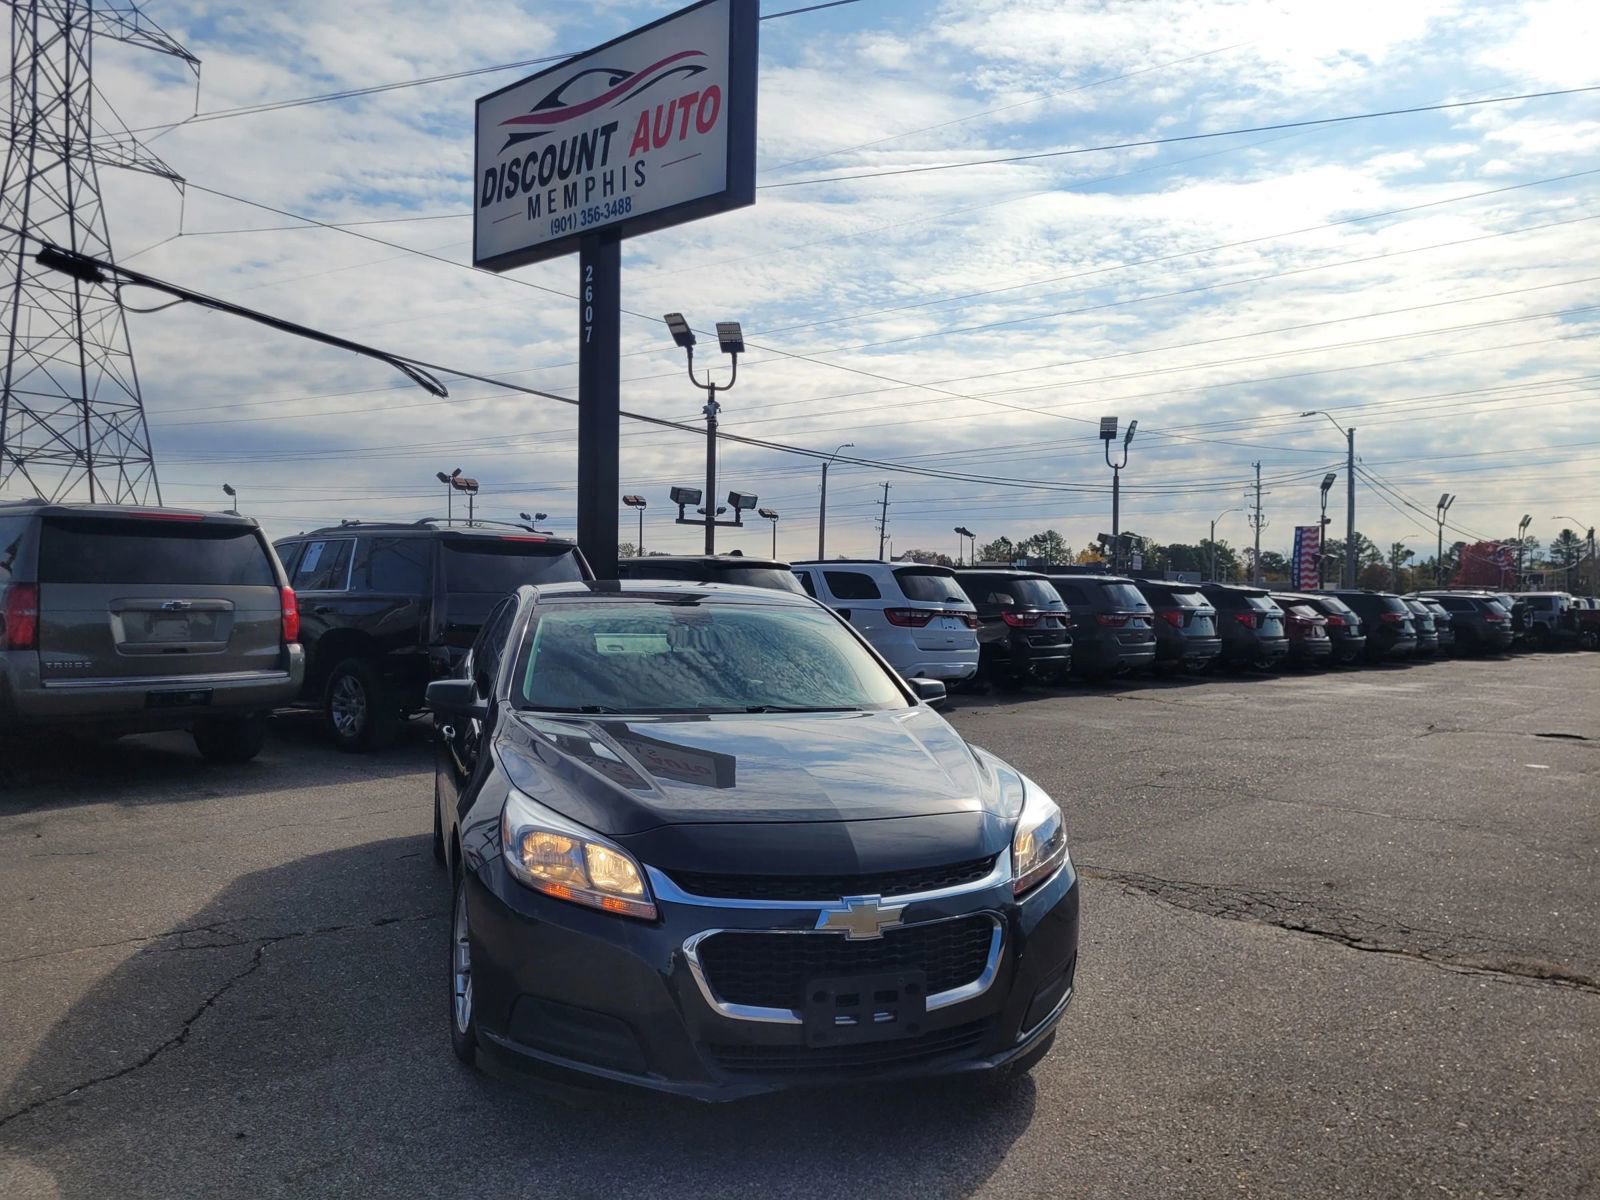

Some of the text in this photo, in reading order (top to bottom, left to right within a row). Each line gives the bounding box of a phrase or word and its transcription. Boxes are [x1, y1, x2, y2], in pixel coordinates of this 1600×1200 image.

[481, 84, 722, 208] DISCOUNT AUTO
[527, 159, 646, 221] MEMPHIS
[550, 195, 632, 236] (901) 356-3488
[584, 264, 594, 343] 2607
